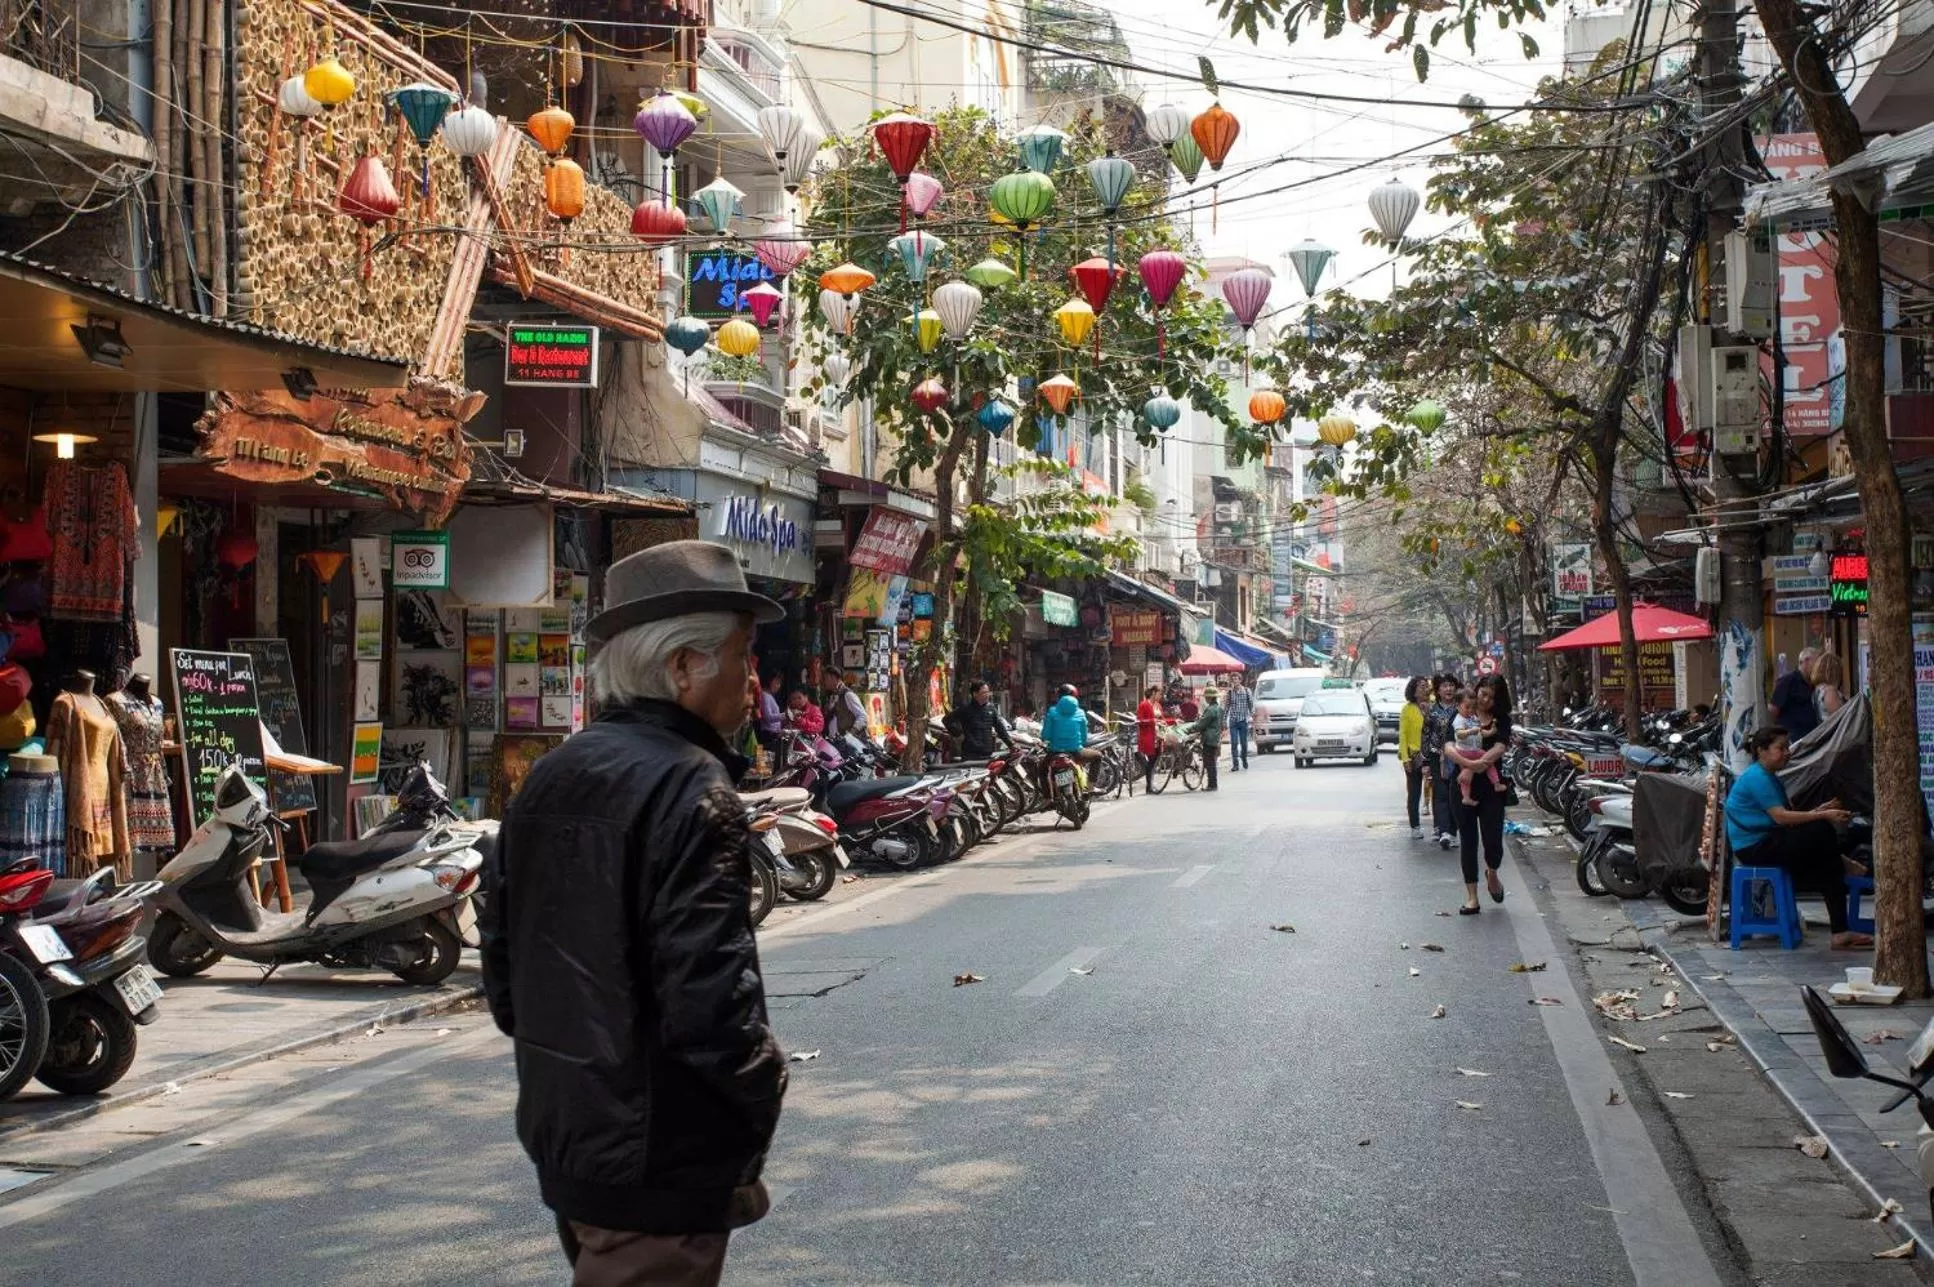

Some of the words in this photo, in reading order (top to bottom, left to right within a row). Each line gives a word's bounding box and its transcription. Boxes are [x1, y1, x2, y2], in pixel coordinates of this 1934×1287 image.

[514, 331, 534, 342] THE
[535, 331, 554, 343] OLD
[518, 368, 529, 377] 11
[725, 496, 768, 545] Mido
[770, 505, 795, 557] Spa
[177, 652, 193, 669] Set
[204, 728, 219, 747] all
